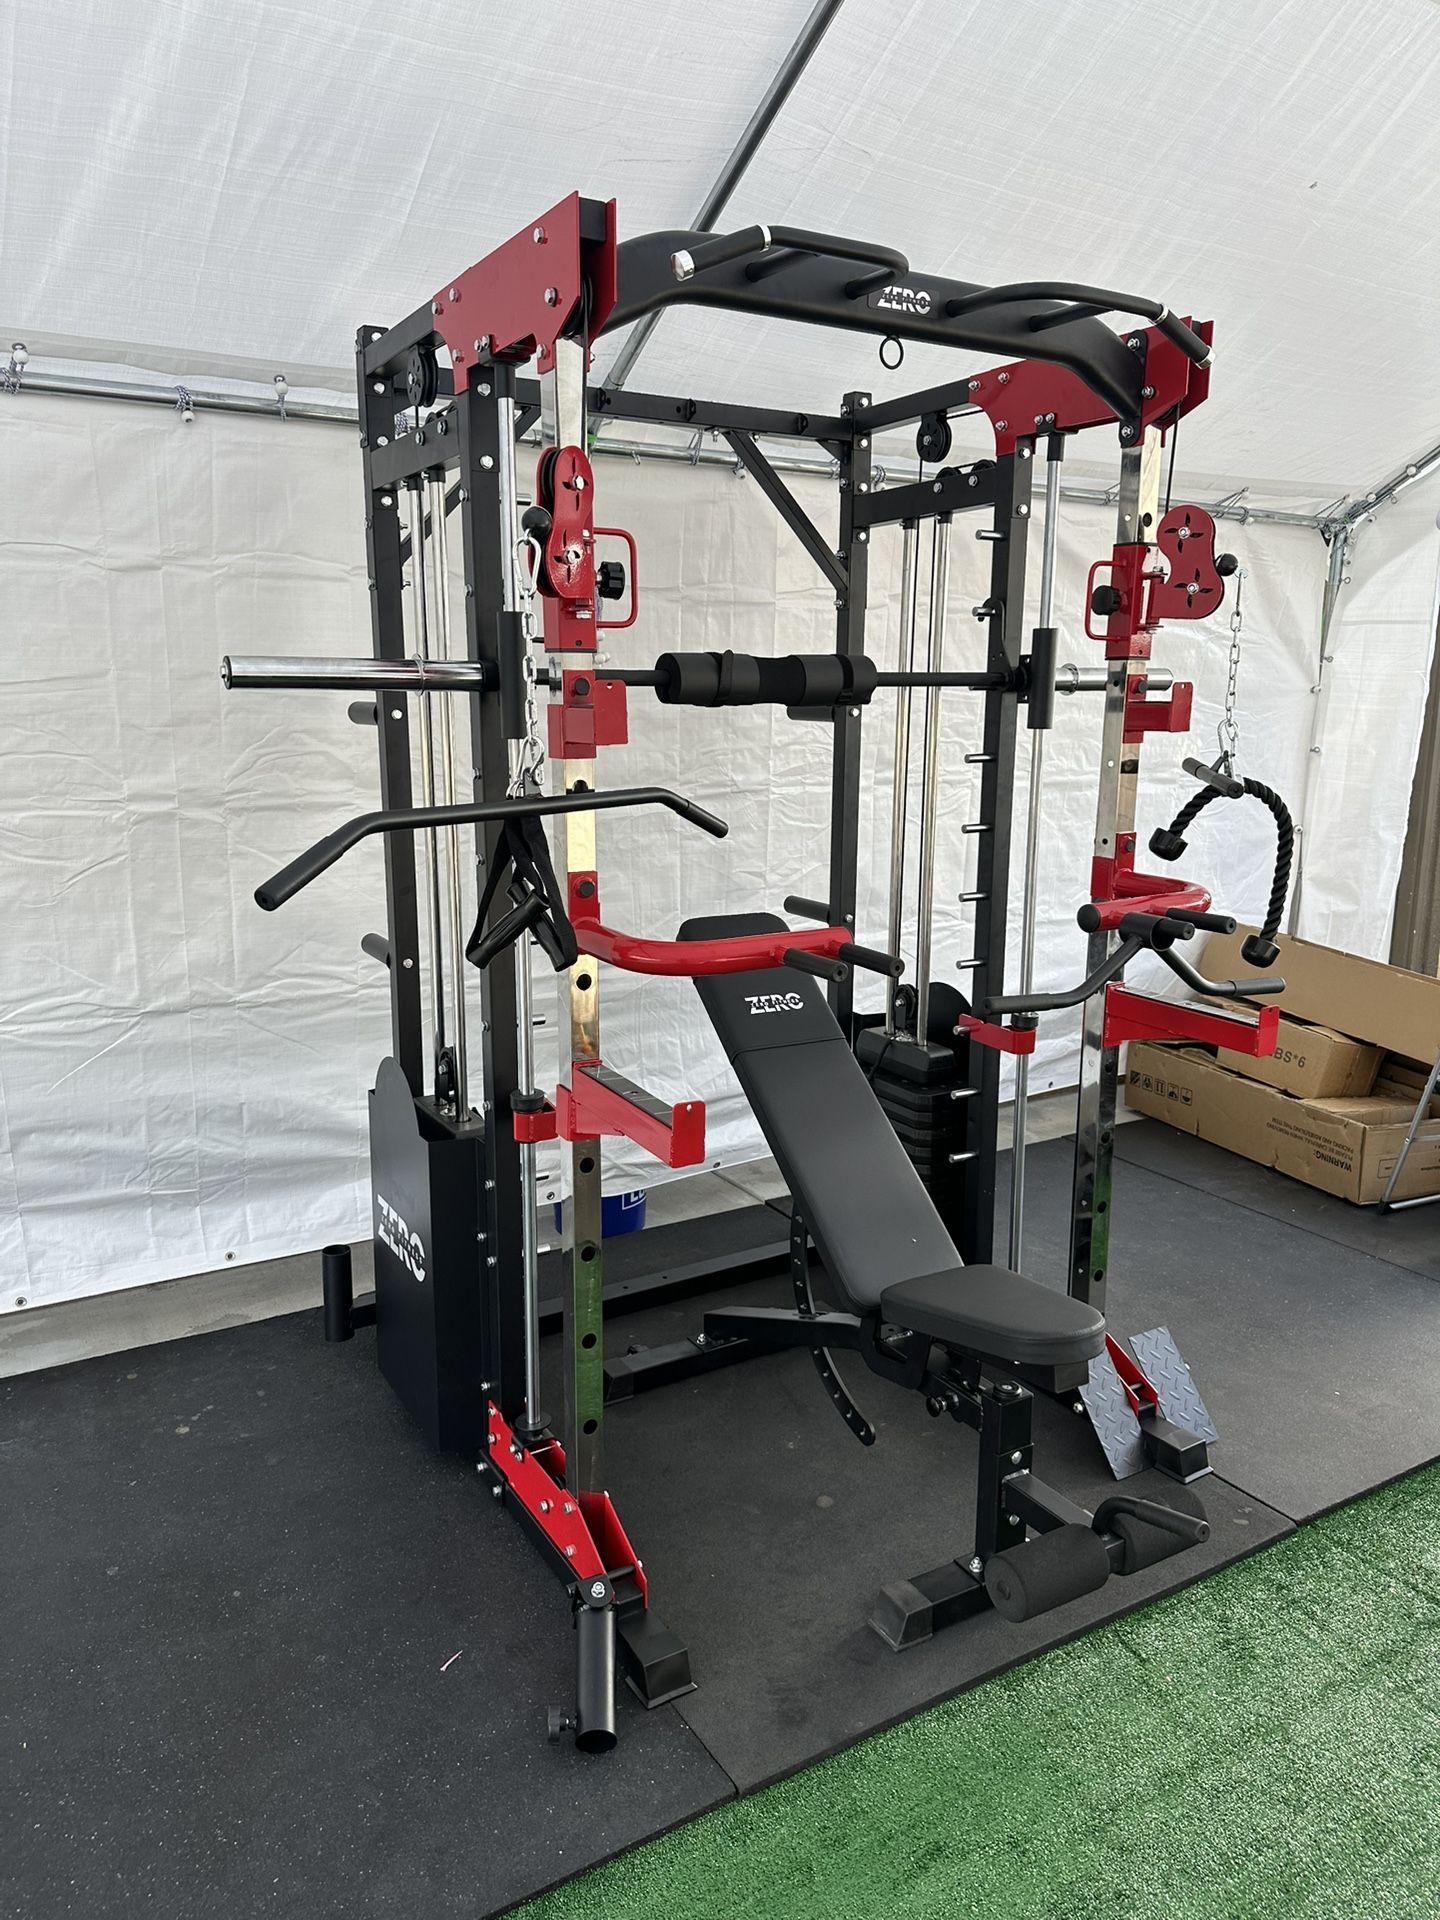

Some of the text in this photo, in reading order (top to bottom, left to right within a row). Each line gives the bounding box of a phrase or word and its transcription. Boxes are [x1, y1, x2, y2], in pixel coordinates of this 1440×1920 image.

[877, 285, 931, 315] ZERO
[744, 992, 804, 1015] ZERO
[1313, 1148, 1352, 1172] WARNING:
[377, 1193, 426, 1282] ZERO
